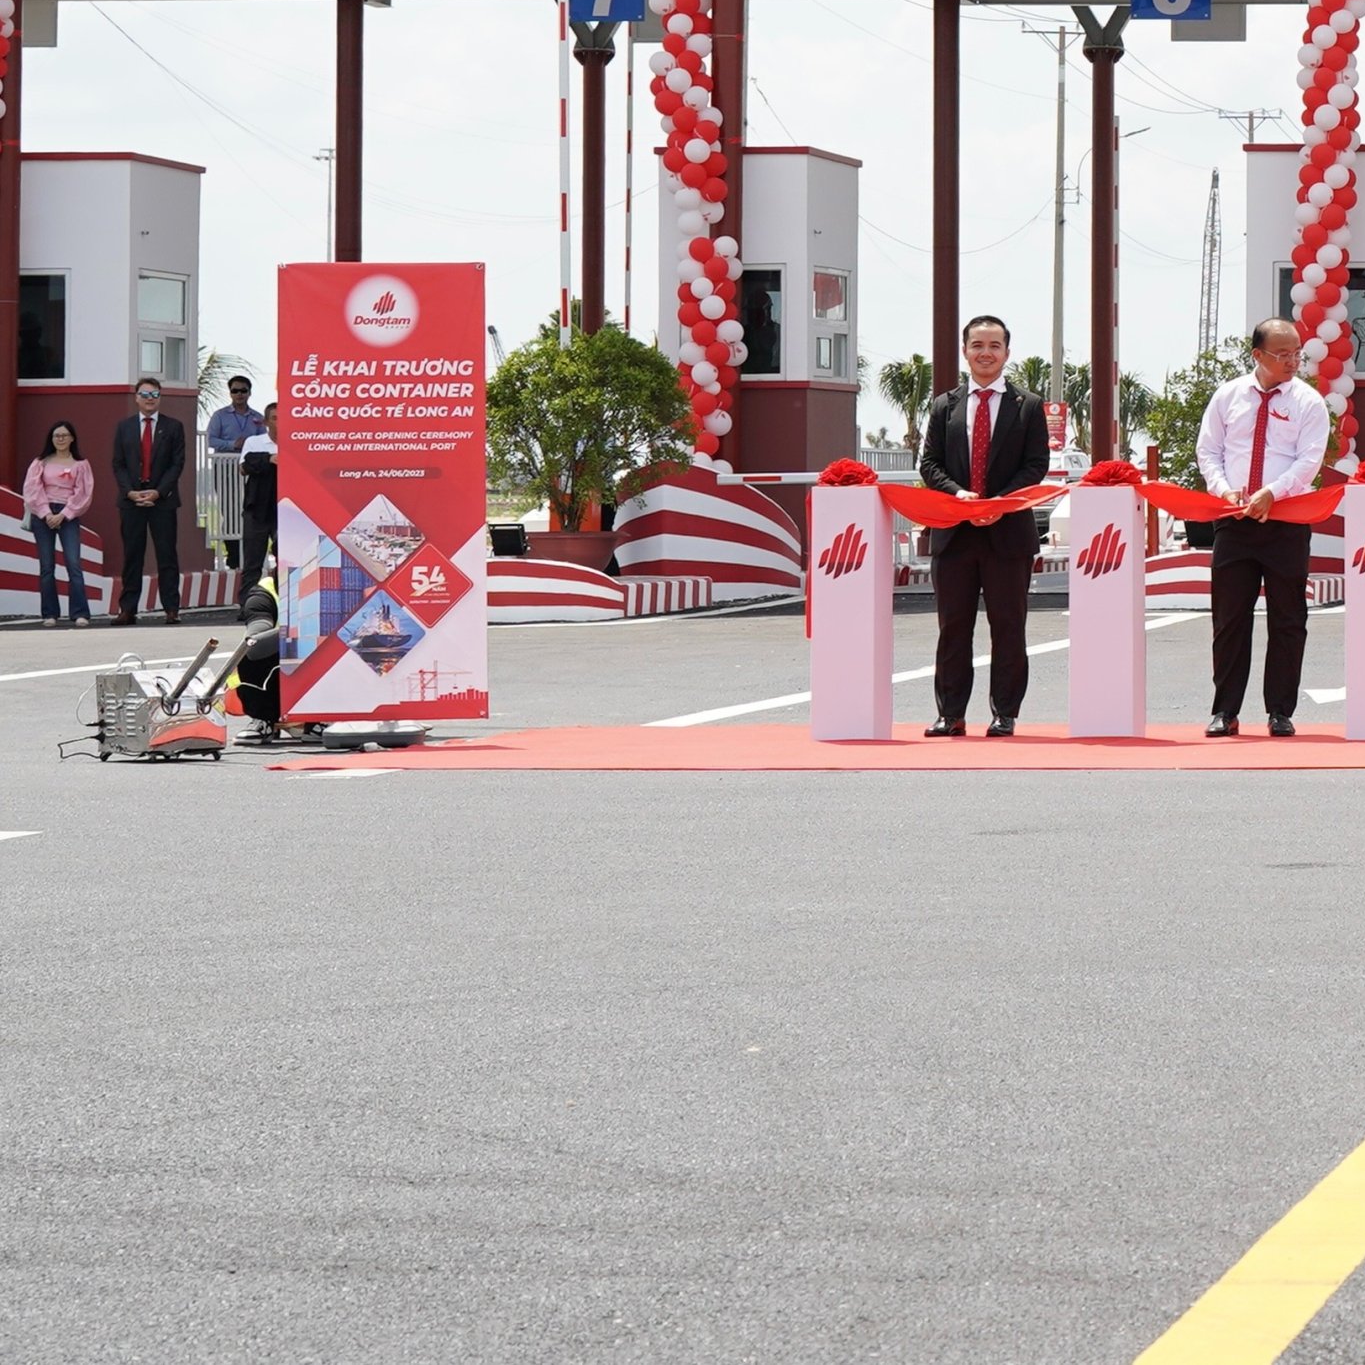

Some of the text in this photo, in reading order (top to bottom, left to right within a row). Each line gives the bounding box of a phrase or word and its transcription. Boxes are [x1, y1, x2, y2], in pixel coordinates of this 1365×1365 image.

[354, 315, 411, 327] Dongtam
[290, 354, 474, 376] LỄ KHAI TRƯƠNG
[355, 383, 474, 398] CONTAINER
[291, 403, 474, 419] CẢNG QUỐC TẾ LONG AN
[291, 431, 474, 440] CONTAINER GATE OPENING CEREMONY
[308, 442, 457, 451] LONG AN INTERNATIONAL PORT
[339, 470, 361, 479] Long
[411, 566, 446, 591] 54
